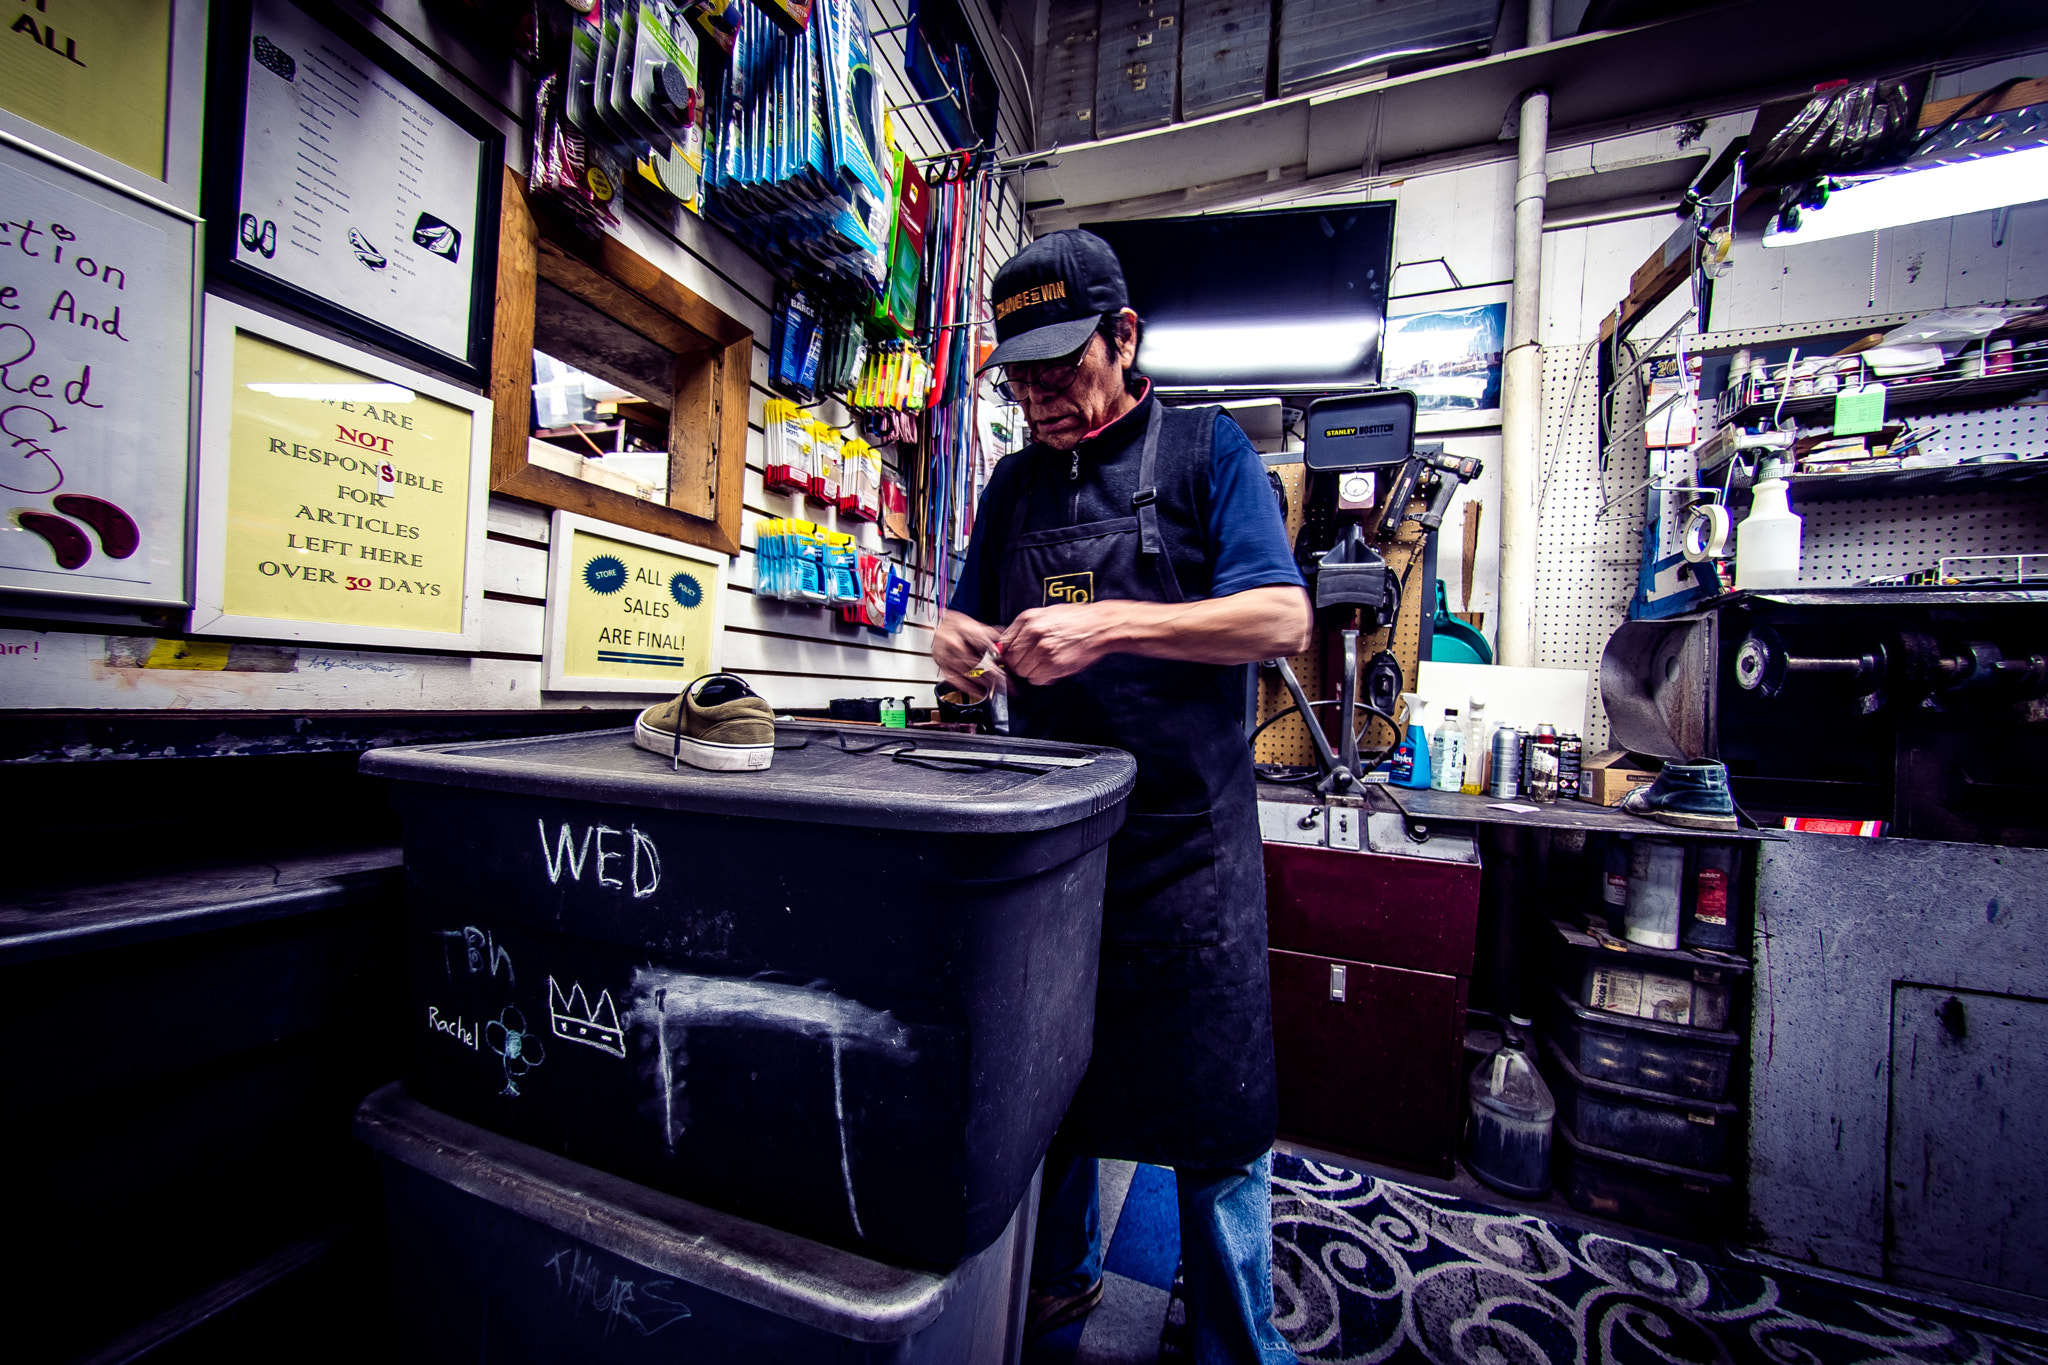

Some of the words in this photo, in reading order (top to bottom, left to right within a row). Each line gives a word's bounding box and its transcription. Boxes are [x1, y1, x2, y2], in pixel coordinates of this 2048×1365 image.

[10, 14, 87, 68] ALL
[791, 298, 815, 318] BARGE
[996, 290, 1030, 320] CHANGE
[1041, 281, 1066, 302] WIN
[48, 290, 129, 342] And
[363, 404, 413, 431] ARE
[1326, 428, 1356, 437] STANLEY
[1359, 424, 1394, 435] BOSTITCH
[336, 424, 393, 454] NOT
[268, 436, 443, 494] RESPONSIBLE
[337, 485, 388, 508] FOR
[295, 505, 420, 540] ARTICLES
[287, 533, 353, 556] LEFT
[360, 545, 423, 568] HERE
[259, 561, 338, 584] OVER
[345, 576, 372, 592] 30
[379, 576, 442, 597] DAYS
[595, 568, 617, 580] STORE
[635, 567, 663, 587] ALL
[678, 582, 697, 597] POLICY
[1048, 581, 1089, 605] GTO
[623, 597, 670, 618] SALES
[598, 627, 633, 646] ARE
[637, 631, 685, 651] FINAL!
[537, 818, 661, 898] WED
[429, 1006, 479, 1051] Rachel
